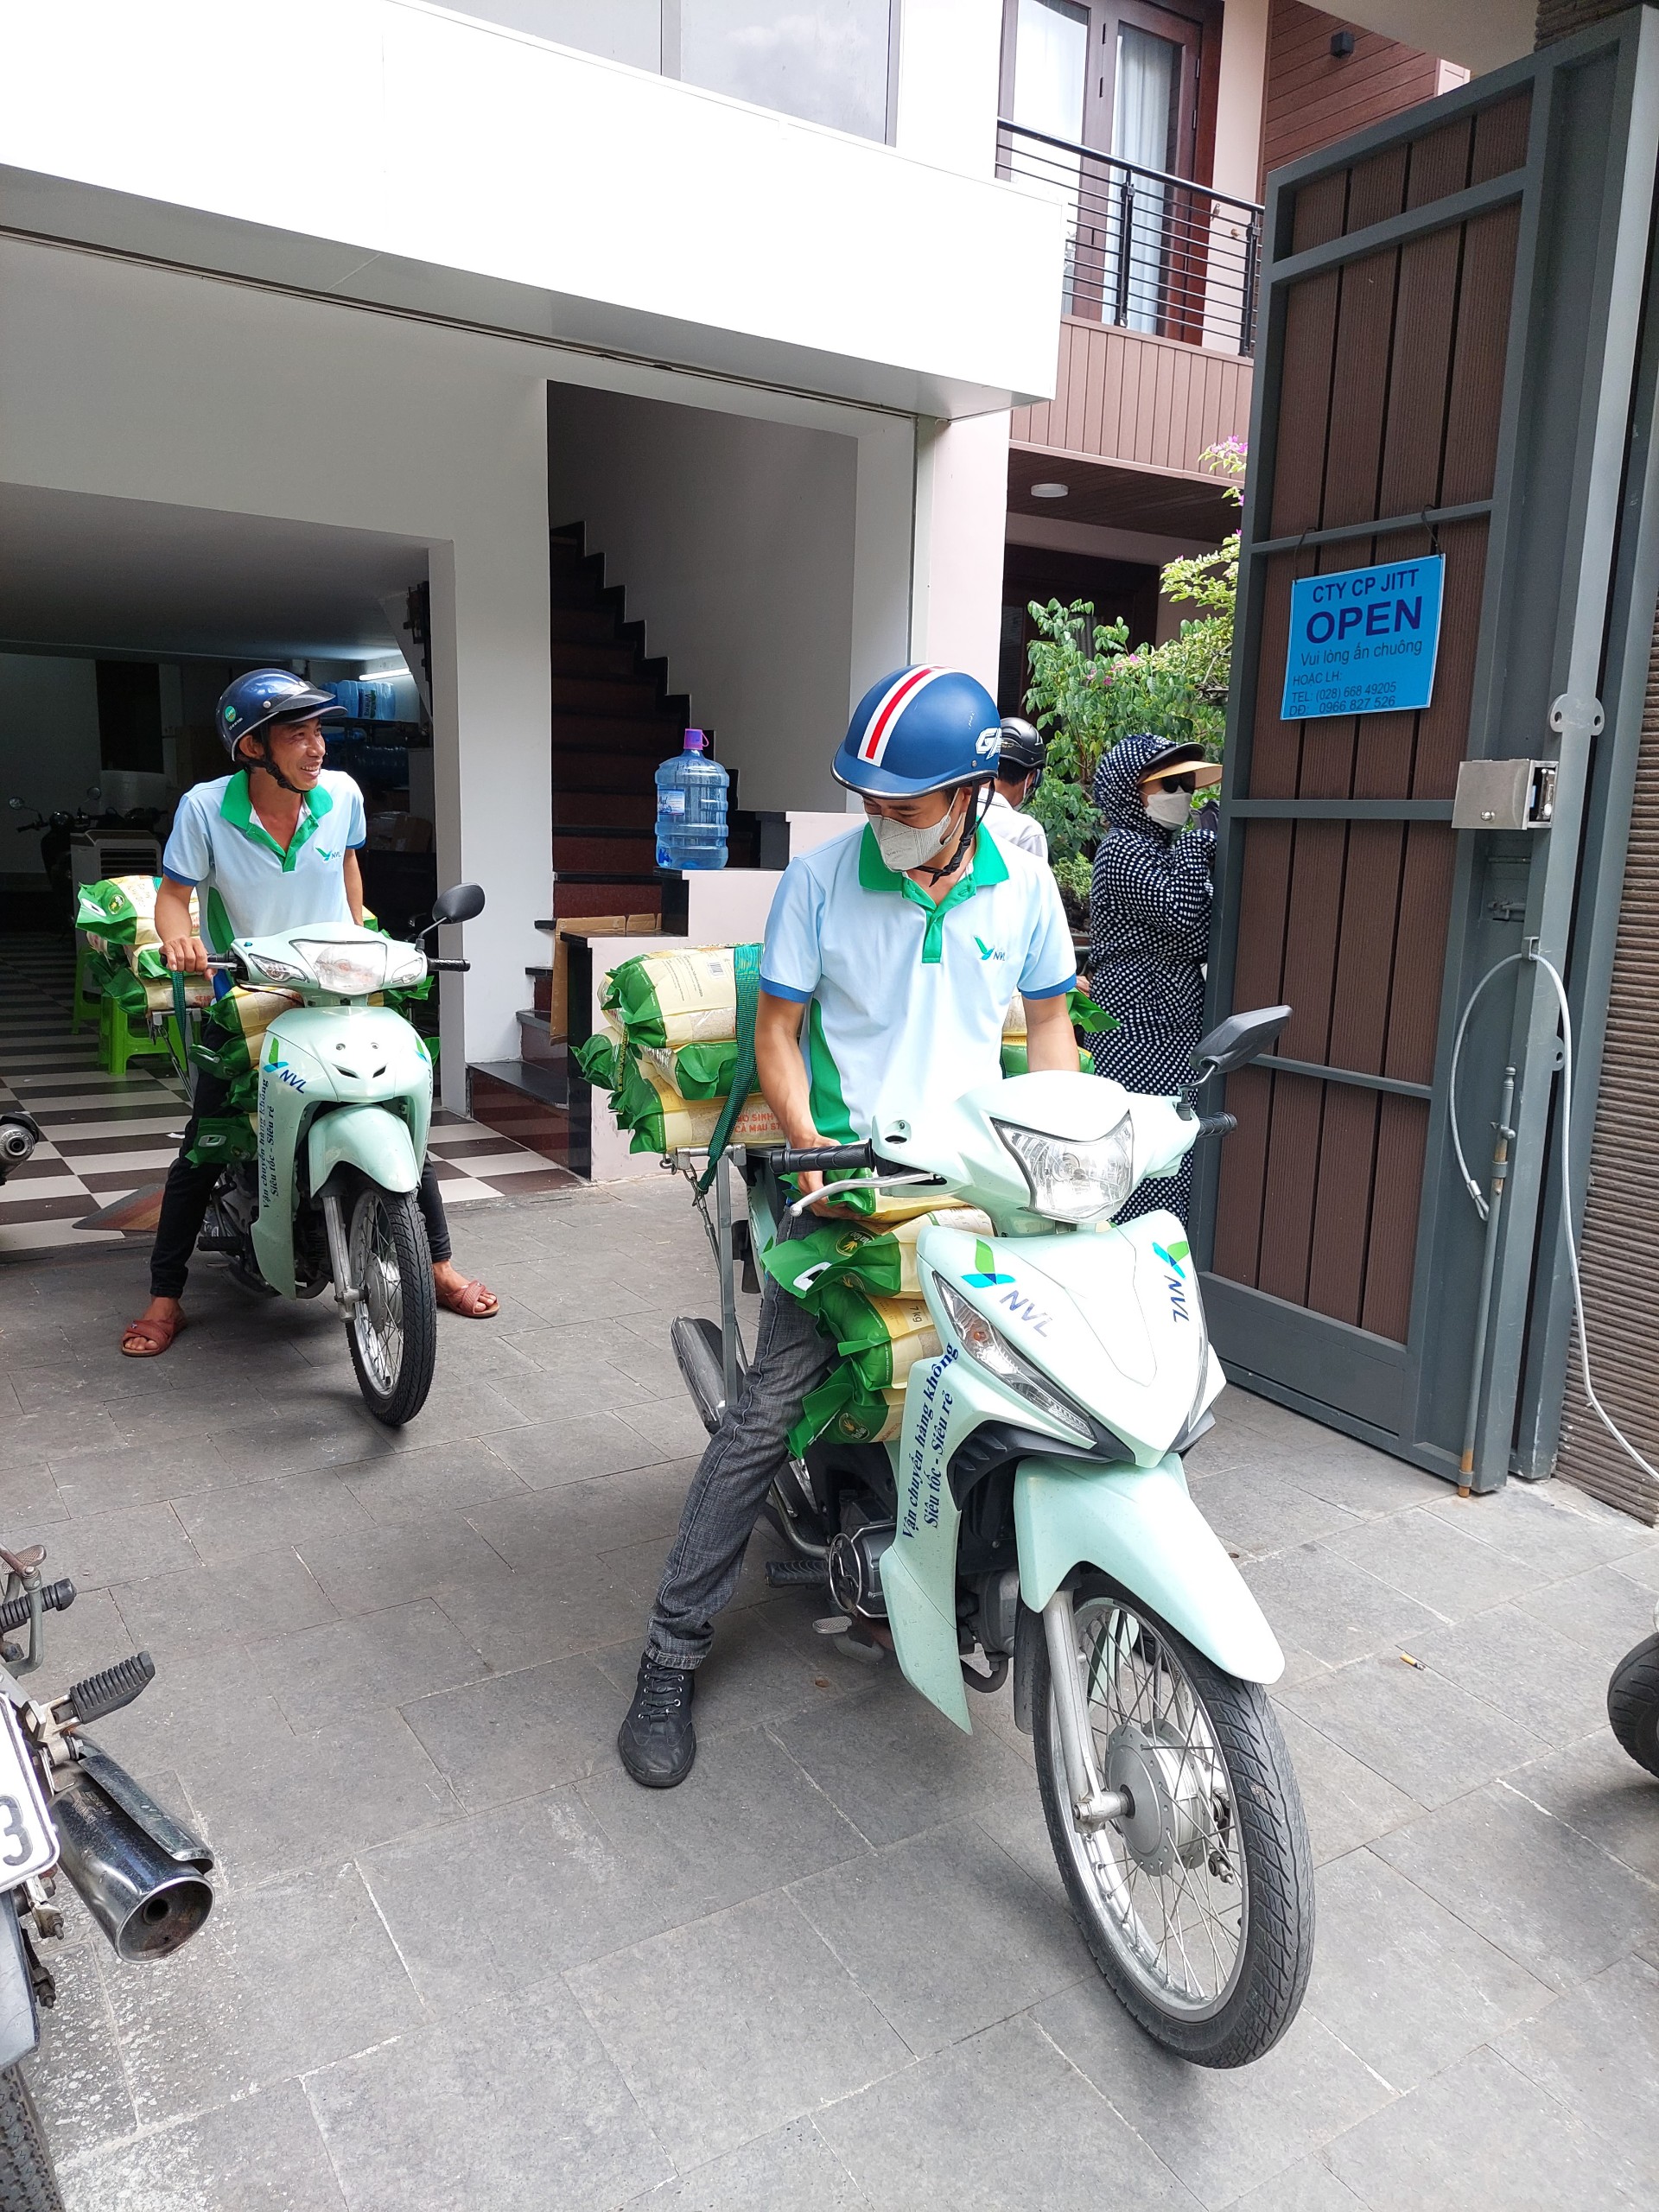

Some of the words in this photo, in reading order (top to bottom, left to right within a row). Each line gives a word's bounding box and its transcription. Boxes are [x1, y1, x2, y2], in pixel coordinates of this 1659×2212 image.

[1313, 582, 1346, 603] CTY
[1351, 576, 1376, 596] CP
[1381, 569, 1420, 592] JITT
[1306, 596, 1422, 644] OPEN
[1300, 650, 1319, 666] Vui
[1323, 649, 1350, 664] lòng
[1353, 642, 1370, 660] ấn
[1374, 639, 1422, 656] chuông
[1292, 691, 1313, 702] TEL:
[1316, 687, 1341, 702] (028)
[1344, 684, 1363, 698] 668
[1364, 682, 1397, 695] 49205
[1319, 700, 1346, 714] 0966
[1350, 697, 1370, 710] 827
[1374, 696, 1396, 708] 526
[279, 1069, 307, 1094] NVL
[999, 1290, 1052, 1338] NVL
[1163, 1274, 1190, 1323] NVL
[923, 1342, 959, 1403] không
[941, 1389, 954, 1417] rẻ
[915, 1402, 934, 1449] hàng
[931, 1415, 948, 1456] Siêu
[907, 1449, 924, 1508] chuyển
[923, 1467, 942, 1493] tốc
[902, 1509, 919, 1539] Vận
[923, 1494, 940, 1529] Siêu
[0, 1794, 34, 1866] 3
